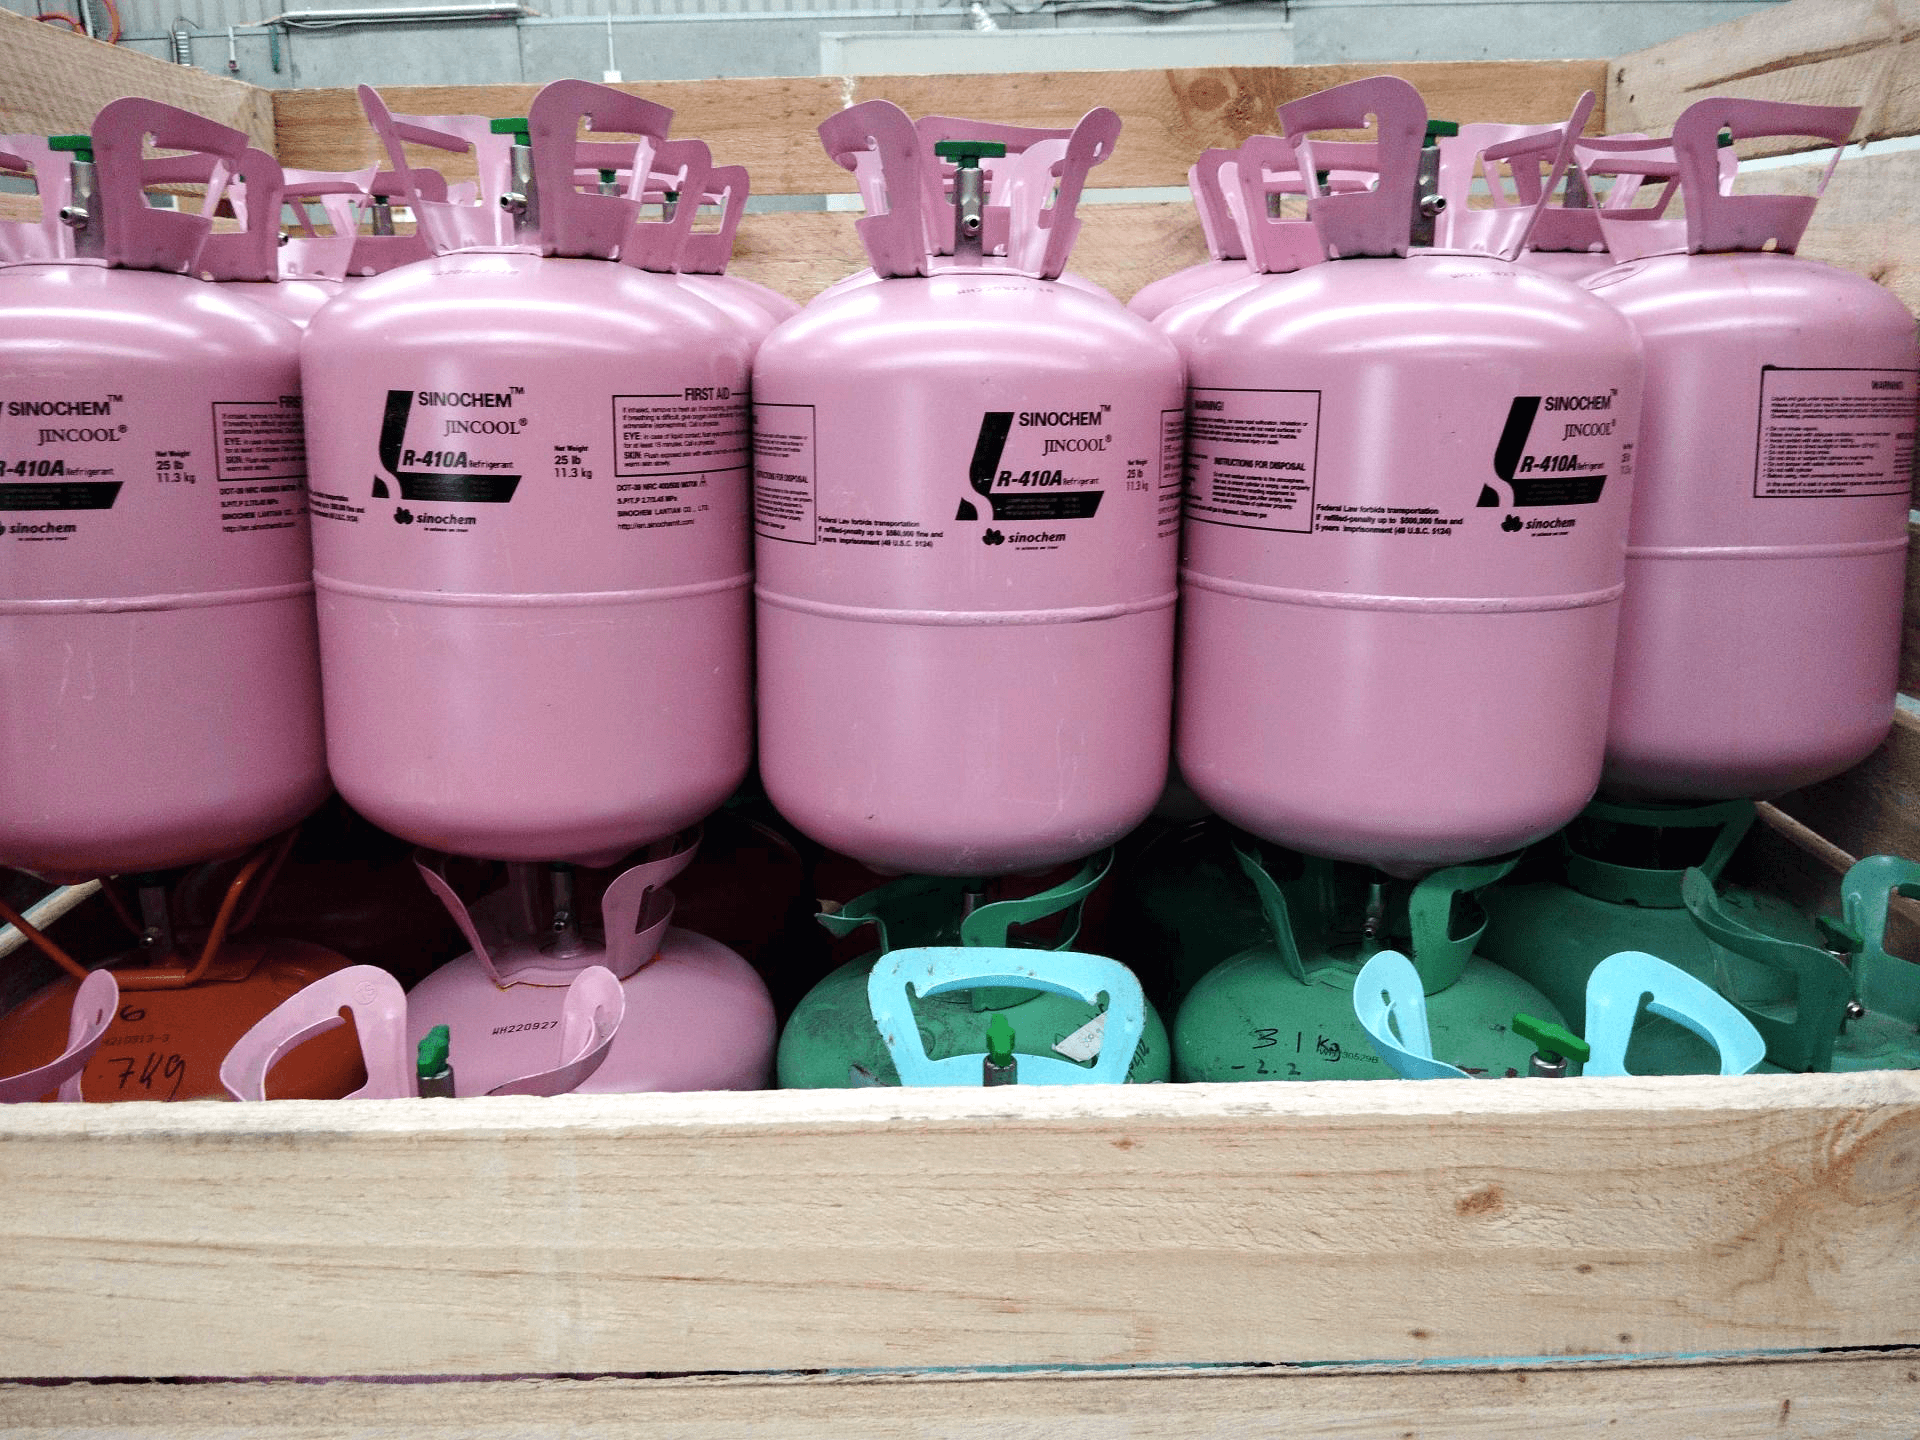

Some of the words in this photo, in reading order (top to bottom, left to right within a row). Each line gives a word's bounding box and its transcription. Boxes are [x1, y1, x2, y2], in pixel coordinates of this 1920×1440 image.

[684, 387, 714, 401] FIRST
[715, 387, 731, 400] AID
[402, 449, 468, 468] R-410A
[554, 455, 569, 465] 25
[571, 454, 582, 465] lb
[1519, 454, 1578, 473] R-410A
[156, 460, 171, 470] 25
[1254, 460, 1268, 469] FOR
[1269, 460, 1306, 471] DISPOSAL
[156, 472, 181, 483] 11.3
[554, 467, 578, 478] 11.3
[581, 467, 593, 479] kg
[996, 469, 1063, 487] R-410A
[1126, 469, 1136, 479] 25
[1316, 504, 1341, 512] Federal
[1360, 505, 1385, 514] forbids
[1387, 507, 1439, 515] transportation
[416, 512, 477, 525] sinochem
[1377, 517, 1388, 525] up
[1434, 517, 1448, 525] fine
[1449, 517, 1464, 525] and
[1525, 517, 1577, 530] sinochem
[8, 521, 77, 534] sinochem
[1320, 525, 1340, 533] years
[1343, 525, 1393, 534] imprisonment
[1007, 531, 1067, 544] sinochem
[492, 1020, 559, 1036] WH220927
